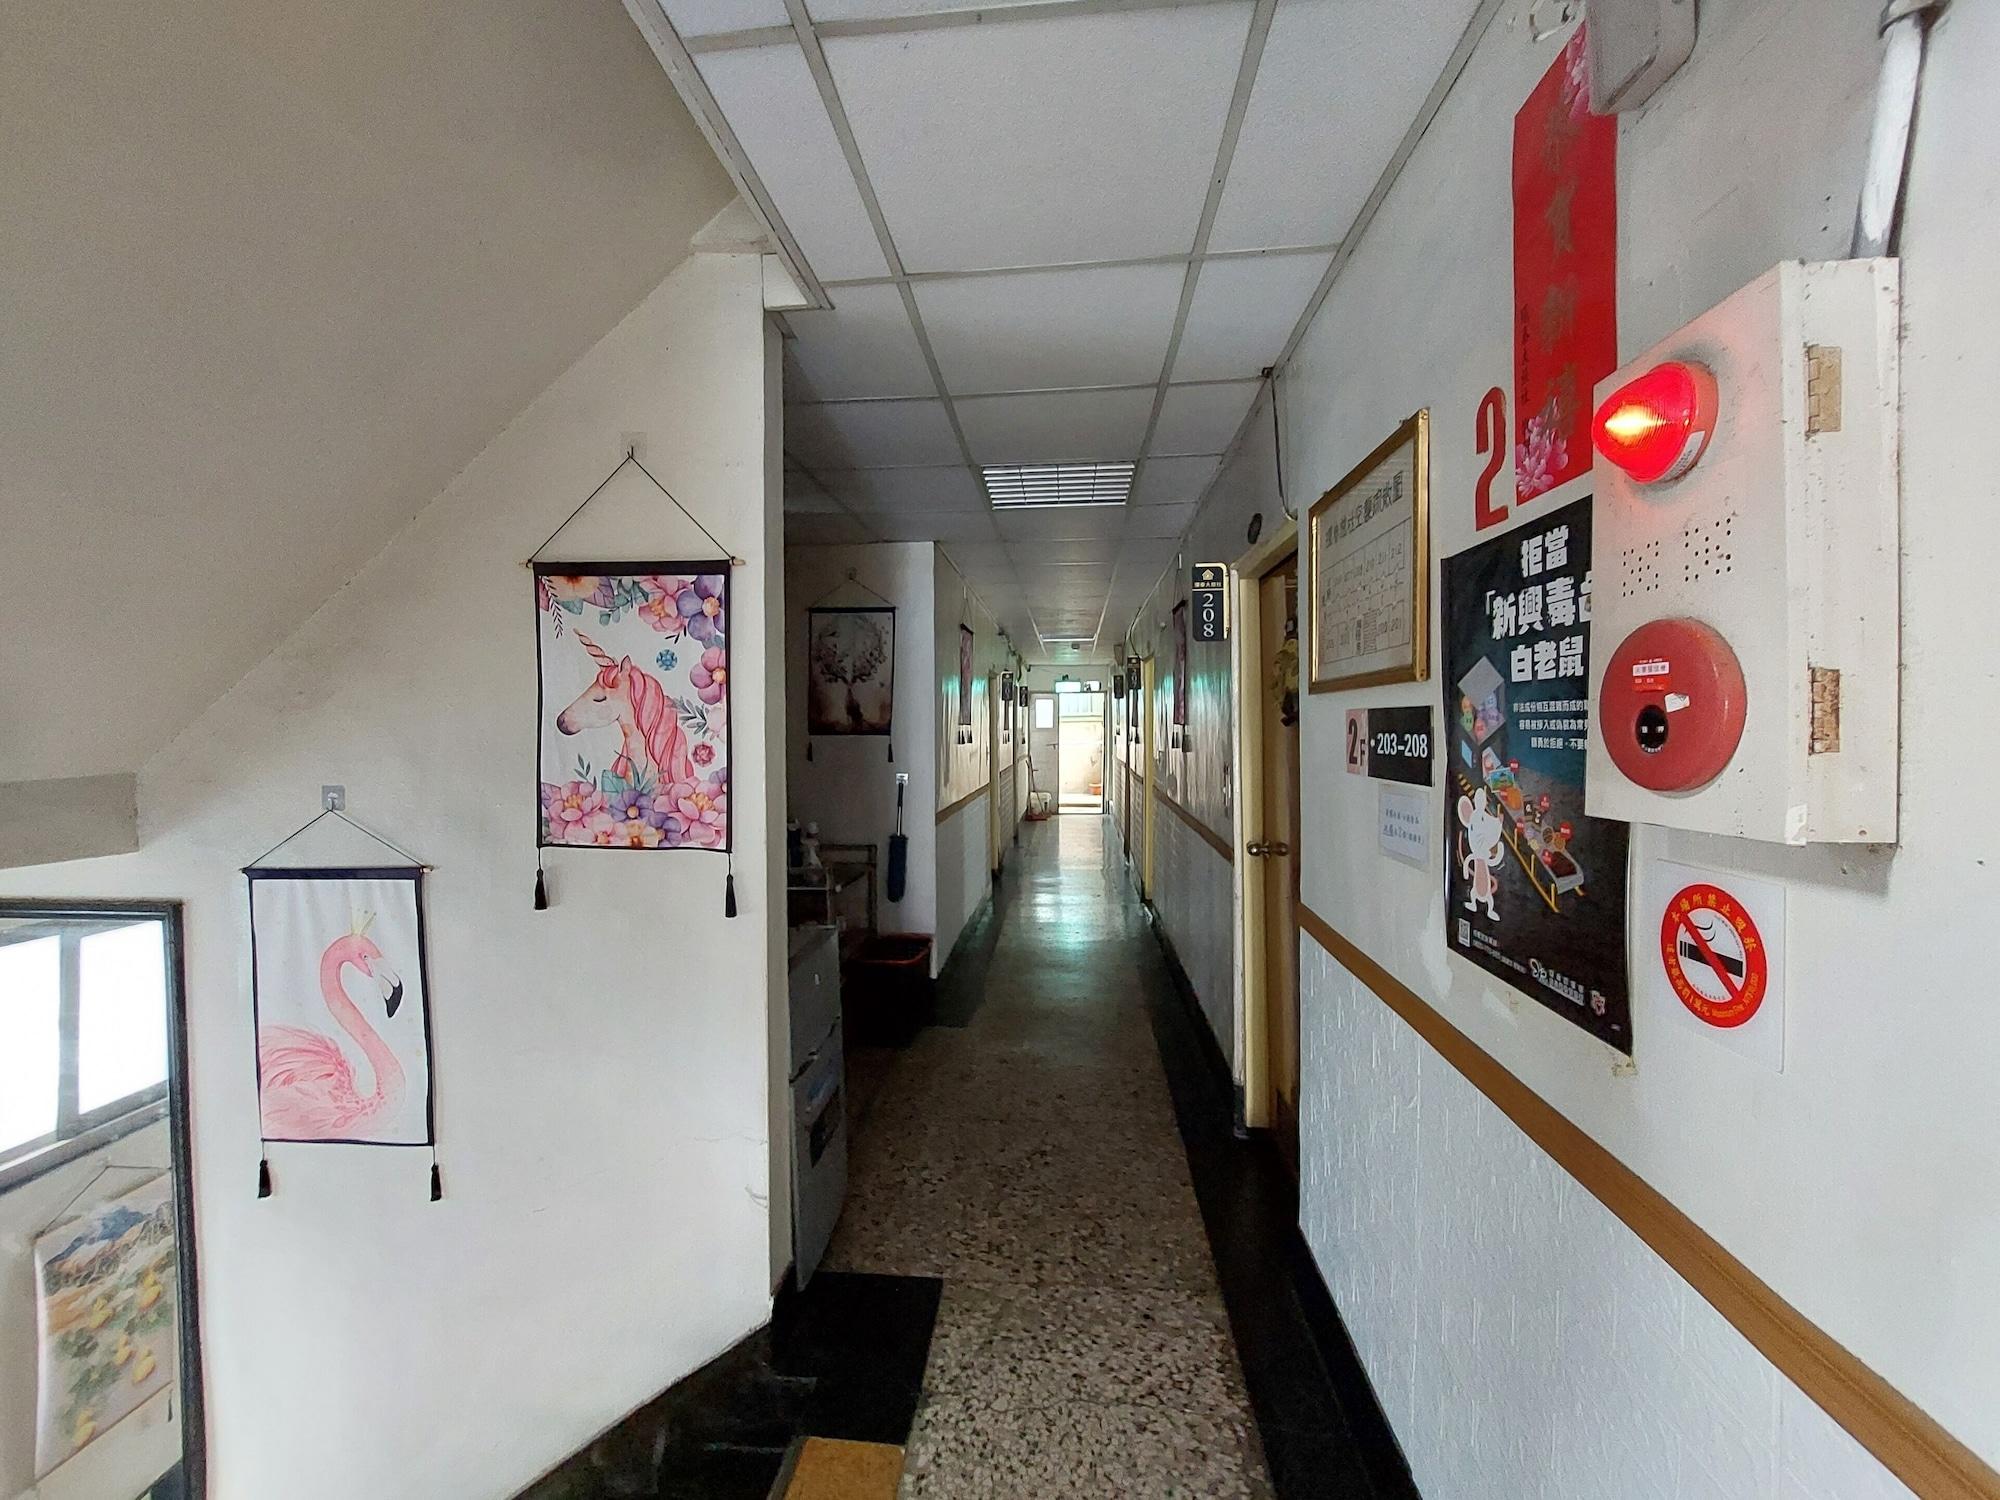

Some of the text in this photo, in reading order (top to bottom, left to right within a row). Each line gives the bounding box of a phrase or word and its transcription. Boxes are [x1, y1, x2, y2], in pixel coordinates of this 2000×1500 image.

[1475, 386, 1509, 532] 2
[1520, 524, 1569, 578] 拒當
[1202, 593, 1215, 638] 208
[1510, 635, 1584, 683] 白老鼠
[1377, 732, 1428, 759] 203-208
